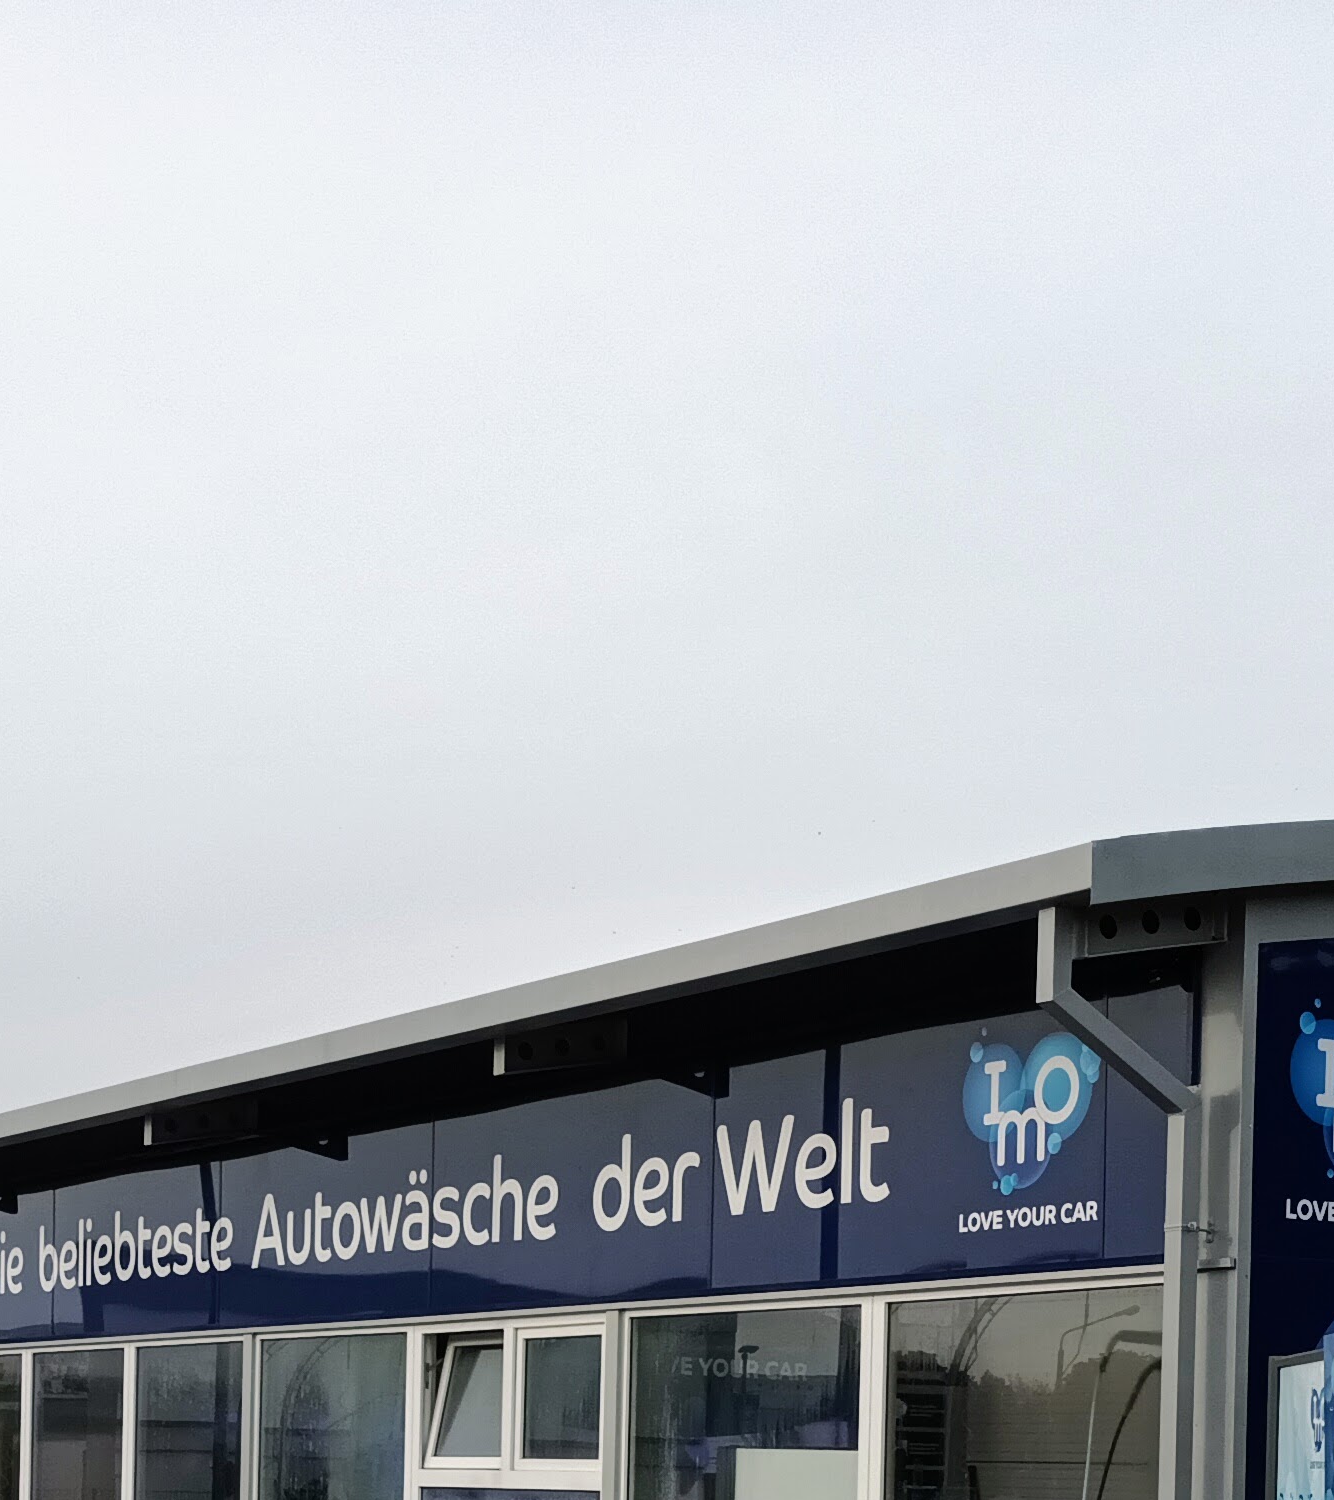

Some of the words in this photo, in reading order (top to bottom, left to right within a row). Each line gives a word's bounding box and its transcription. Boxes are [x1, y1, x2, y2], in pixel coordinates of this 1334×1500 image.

[38, 1208, 234, 1293] beliebteste
[251, 1154, 559, 1269] Autowäsche
[593, 1133, 700, 1232] der
[717, 1098, 890, 1216] Welt
[958, 1209, 1003, 1233] LOVE
[1006, 1204, 1056, 1228] YOUR
[1060, 1200, 1098, 1223] CAR
[698, 1357, 759, 1379] YOUR
[765, 1360, 808, 1382] CAR
